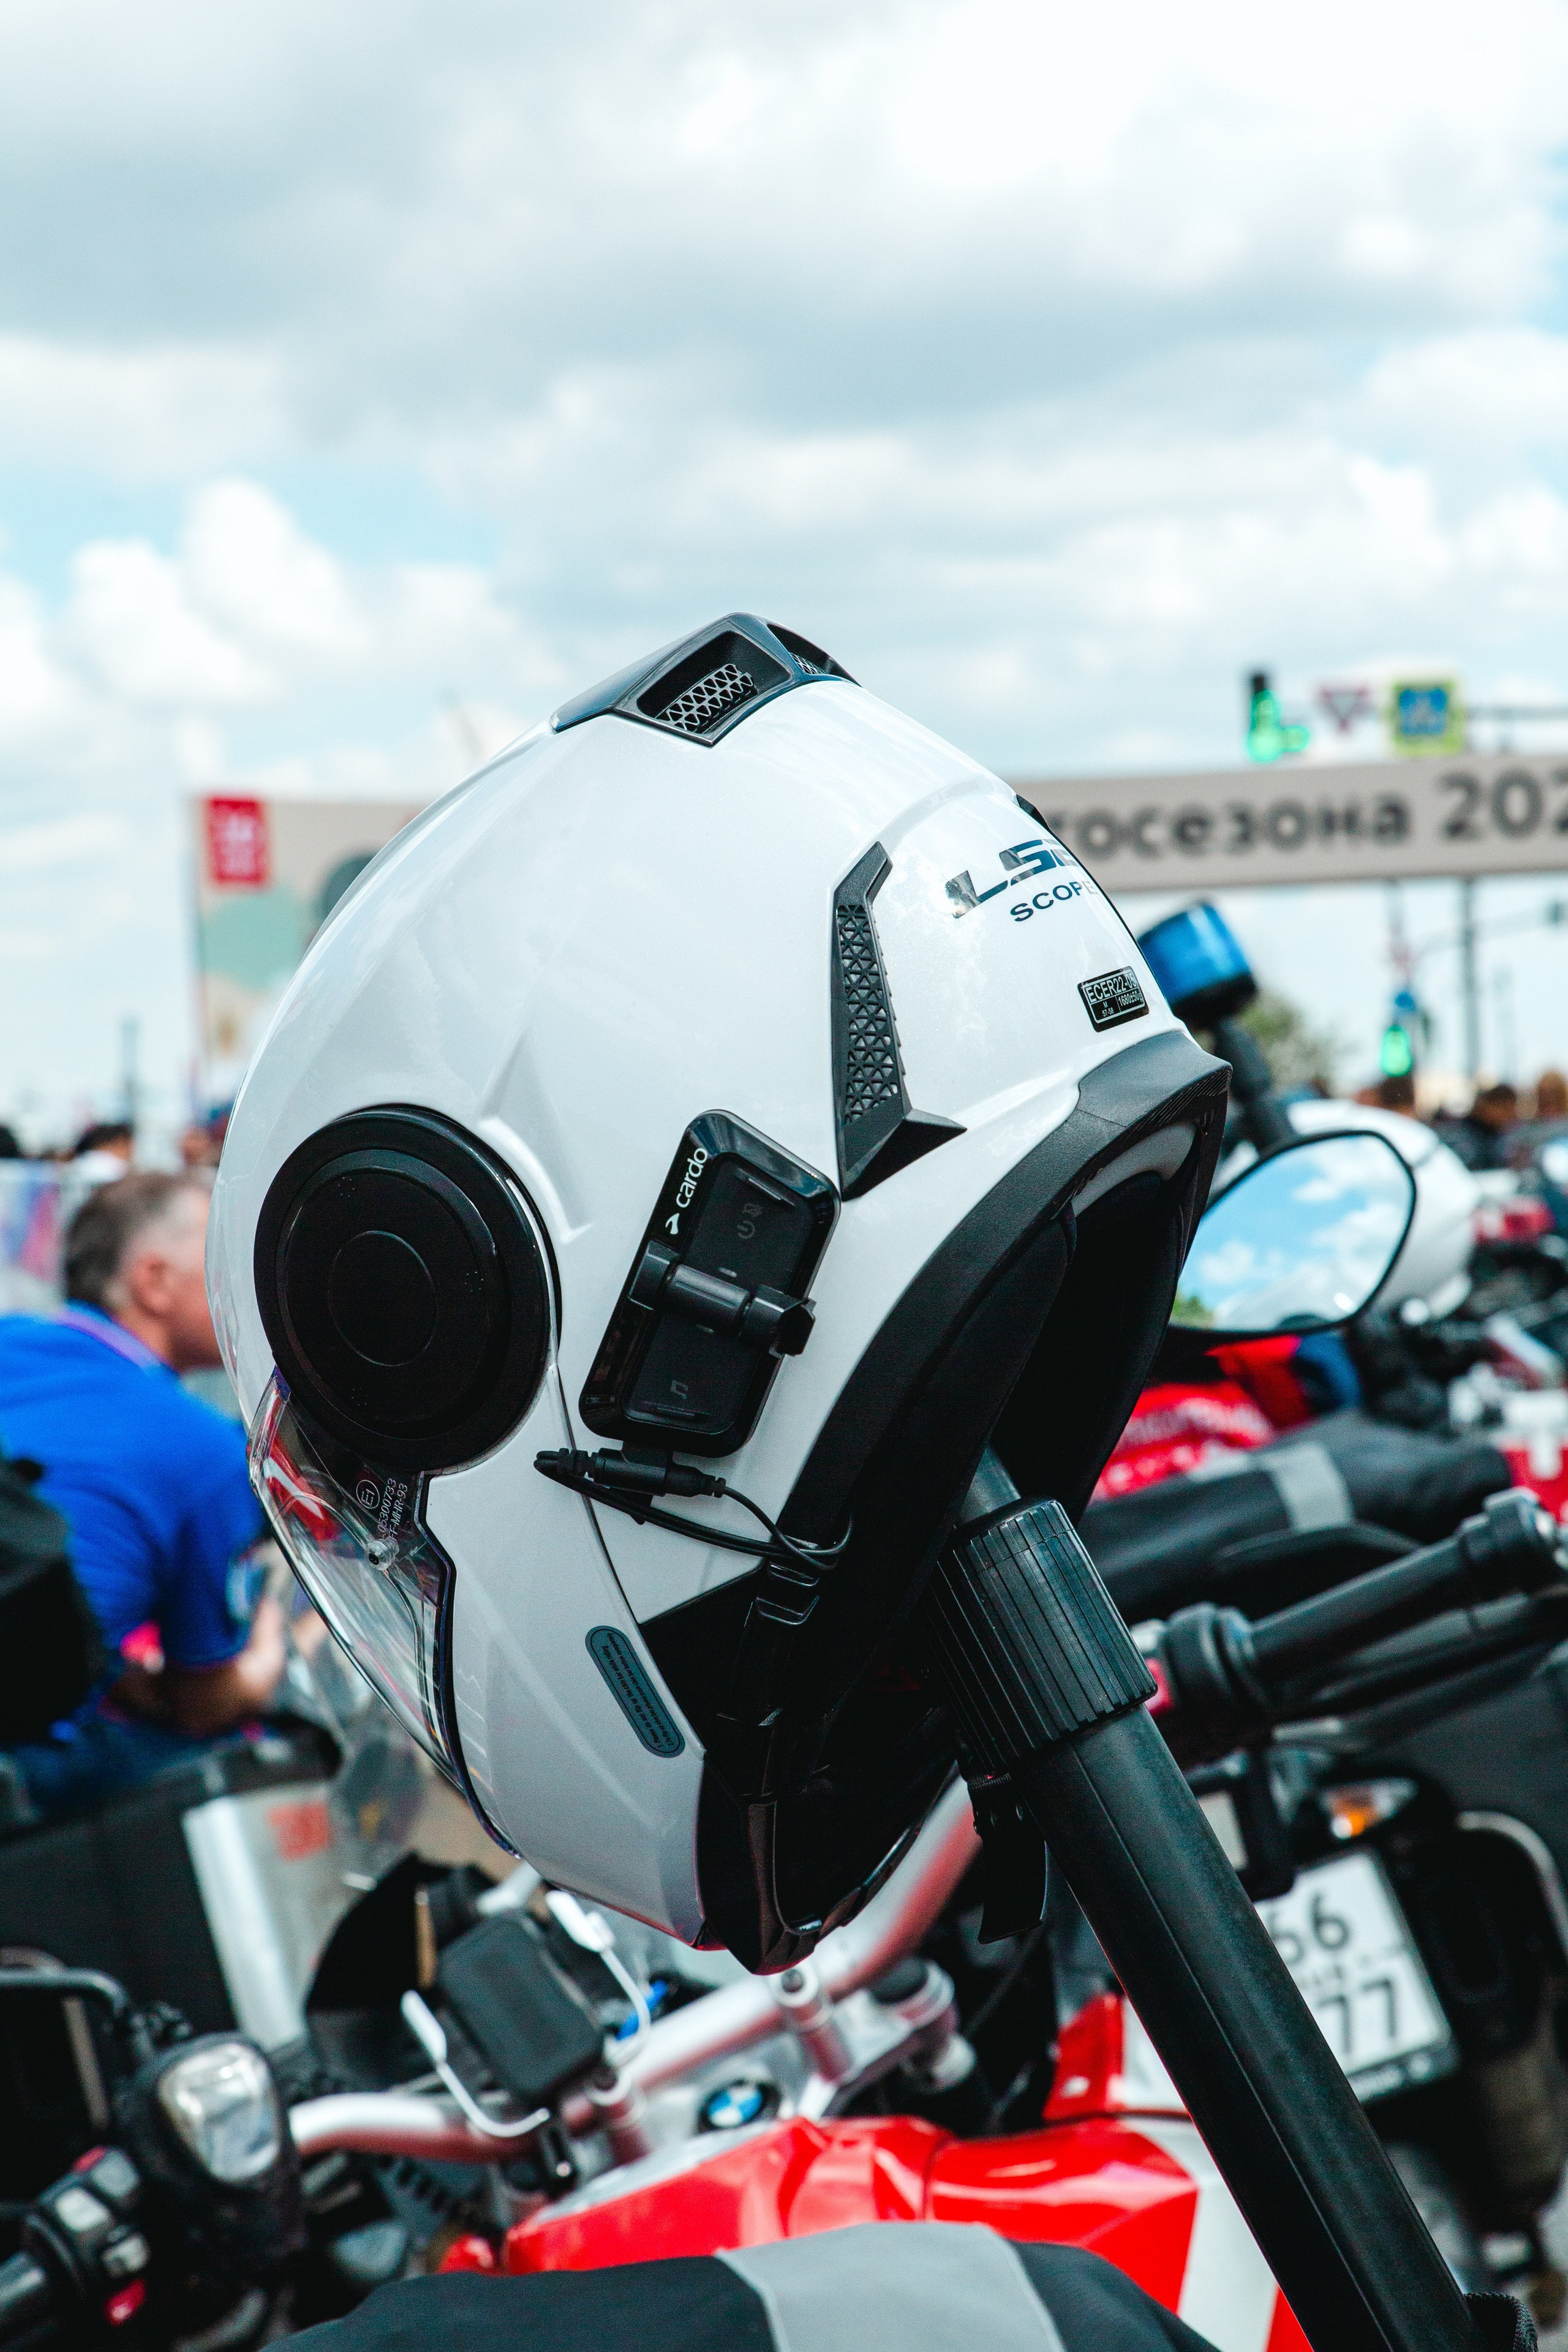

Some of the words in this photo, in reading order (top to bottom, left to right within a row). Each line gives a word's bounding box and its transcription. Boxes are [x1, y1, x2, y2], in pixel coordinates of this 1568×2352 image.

[1010, 880, 1098, 922] SCOPE
[676, 1147, 708, 1208] cardo
[1317, 1978, 1397, 2054] 77
